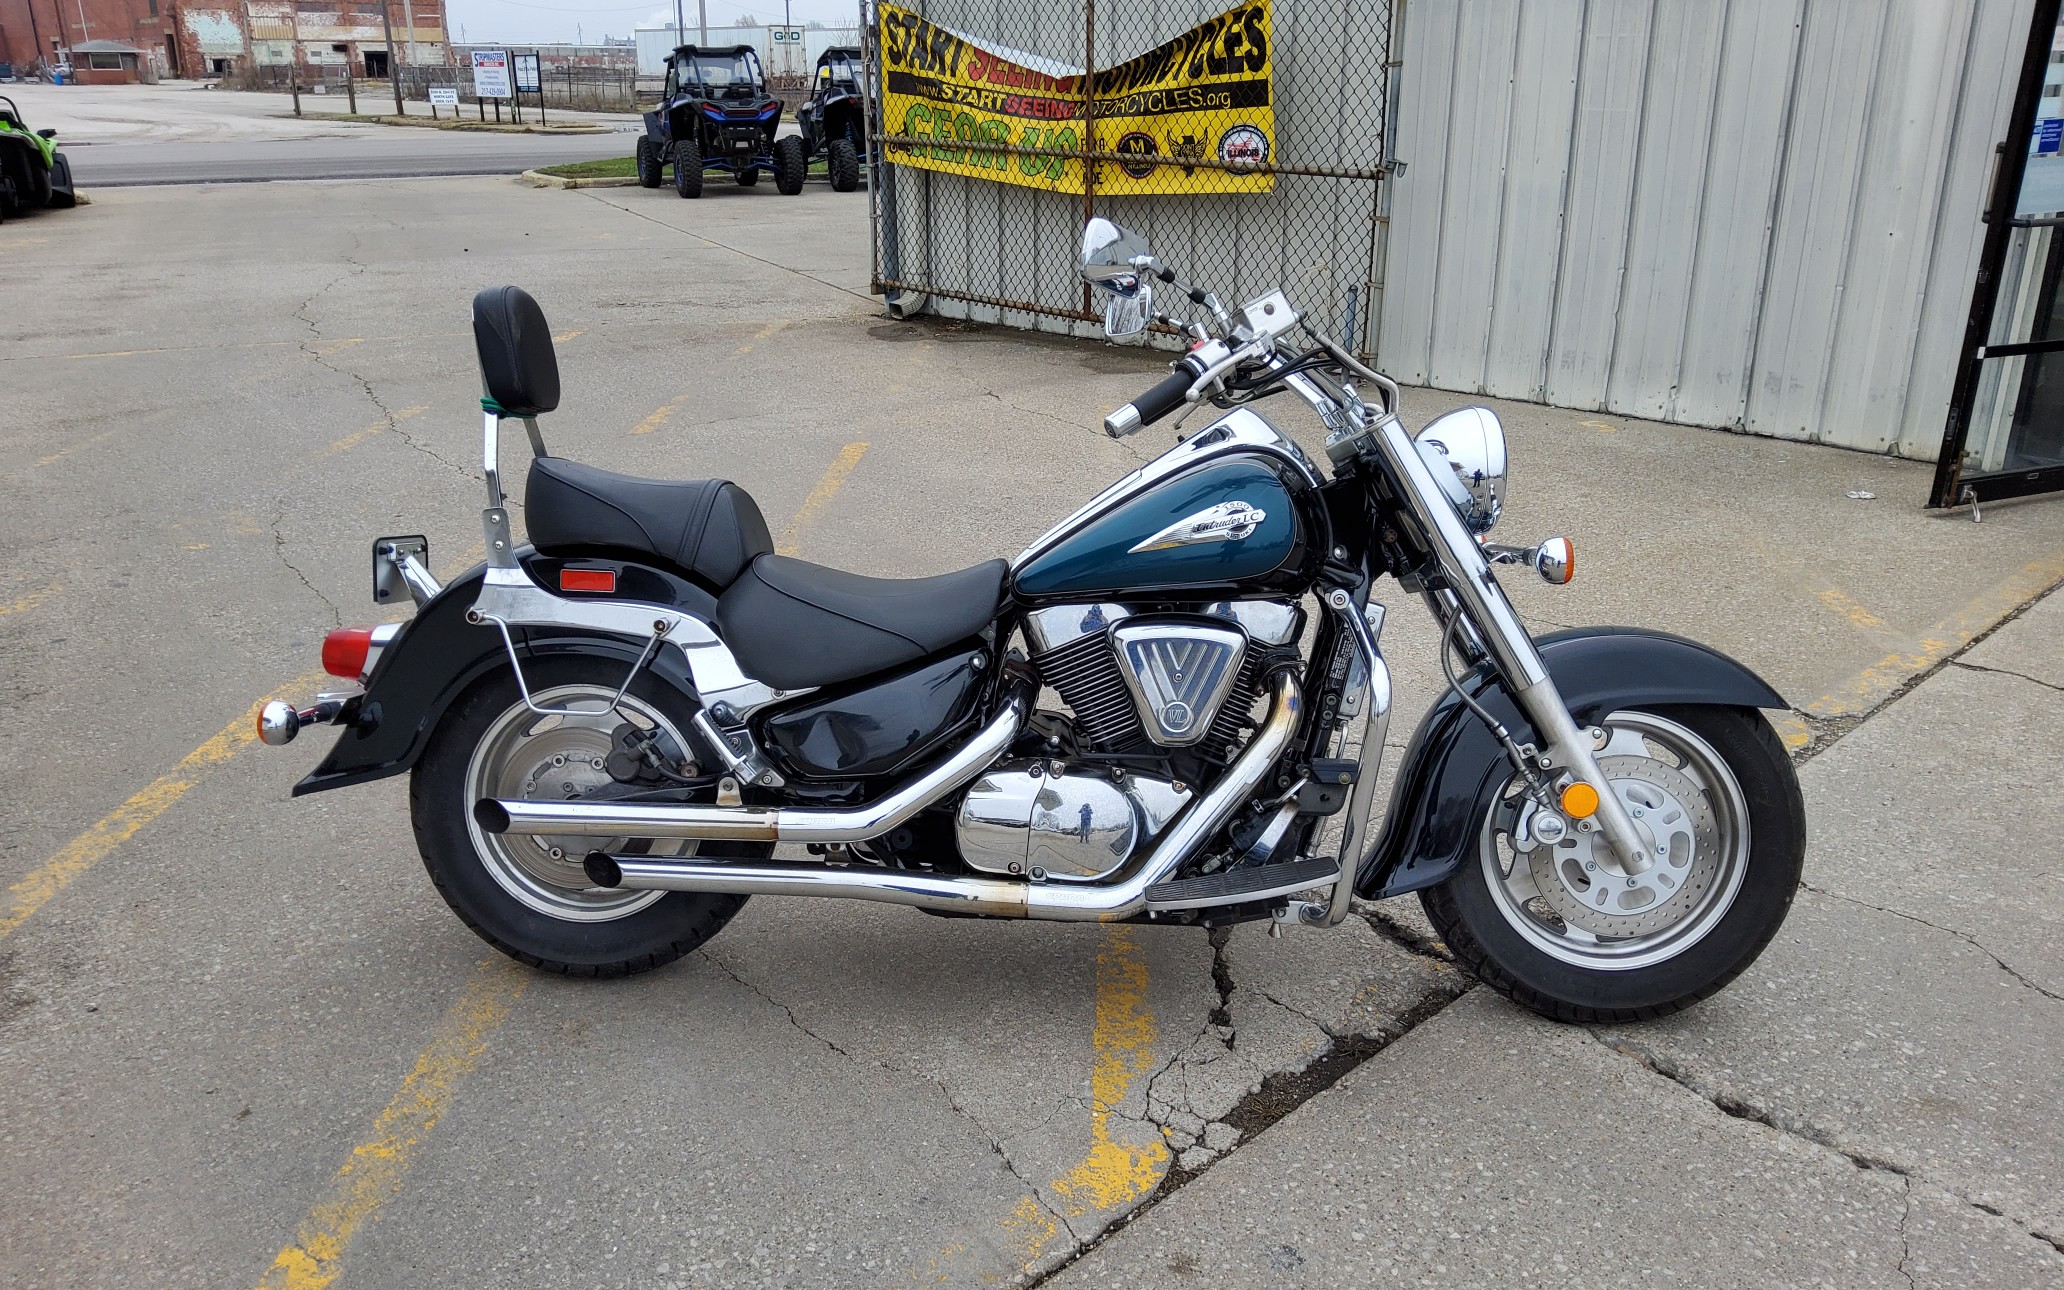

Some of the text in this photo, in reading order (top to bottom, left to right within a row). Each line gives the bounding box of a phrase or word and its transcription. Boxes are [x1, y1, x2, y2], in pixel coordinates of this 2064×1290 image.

[886, 11, 965, 78] START
[1077, 5, 1266, 95] TORCYCLES
[905, 102, 1078, 181] GEAR UP
[1227, 147, 1260, 158] ILLINOIS
[1243, 512, 1259, 522] LC
